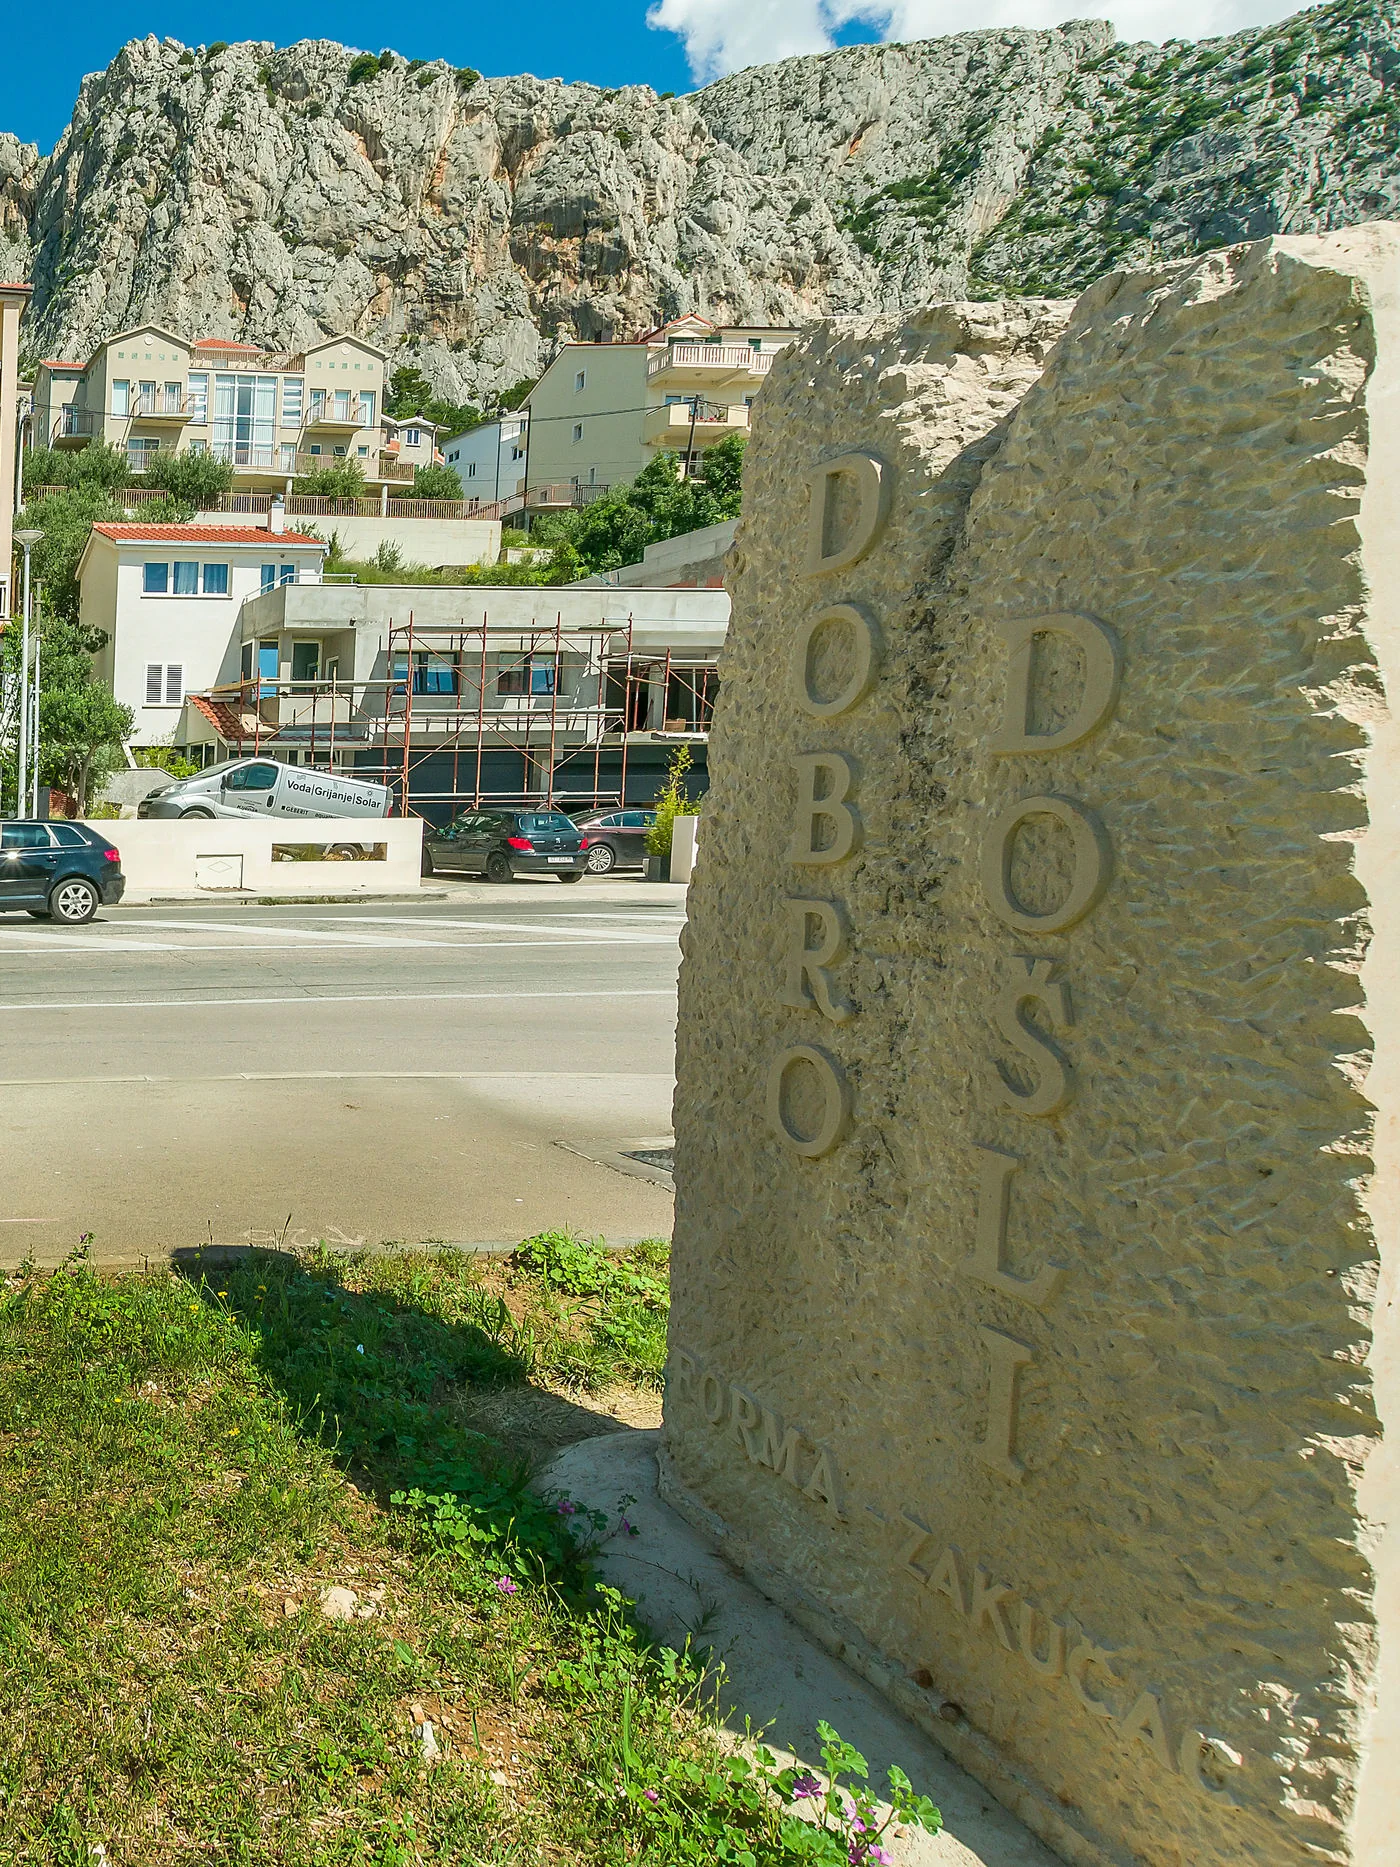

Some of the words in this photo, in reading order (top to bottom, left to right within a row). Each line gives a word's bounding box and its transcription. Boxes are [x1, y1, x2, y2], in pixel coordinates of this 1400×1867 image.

[286, 805, 309, 816] GEBERIT
[287, 779, 311, 794] Voda
[355, 796, 382, 809] Solar
[766, 450, 890, 1158] DOBRO
[962, 609, 1123, 1482] DOŠLI
